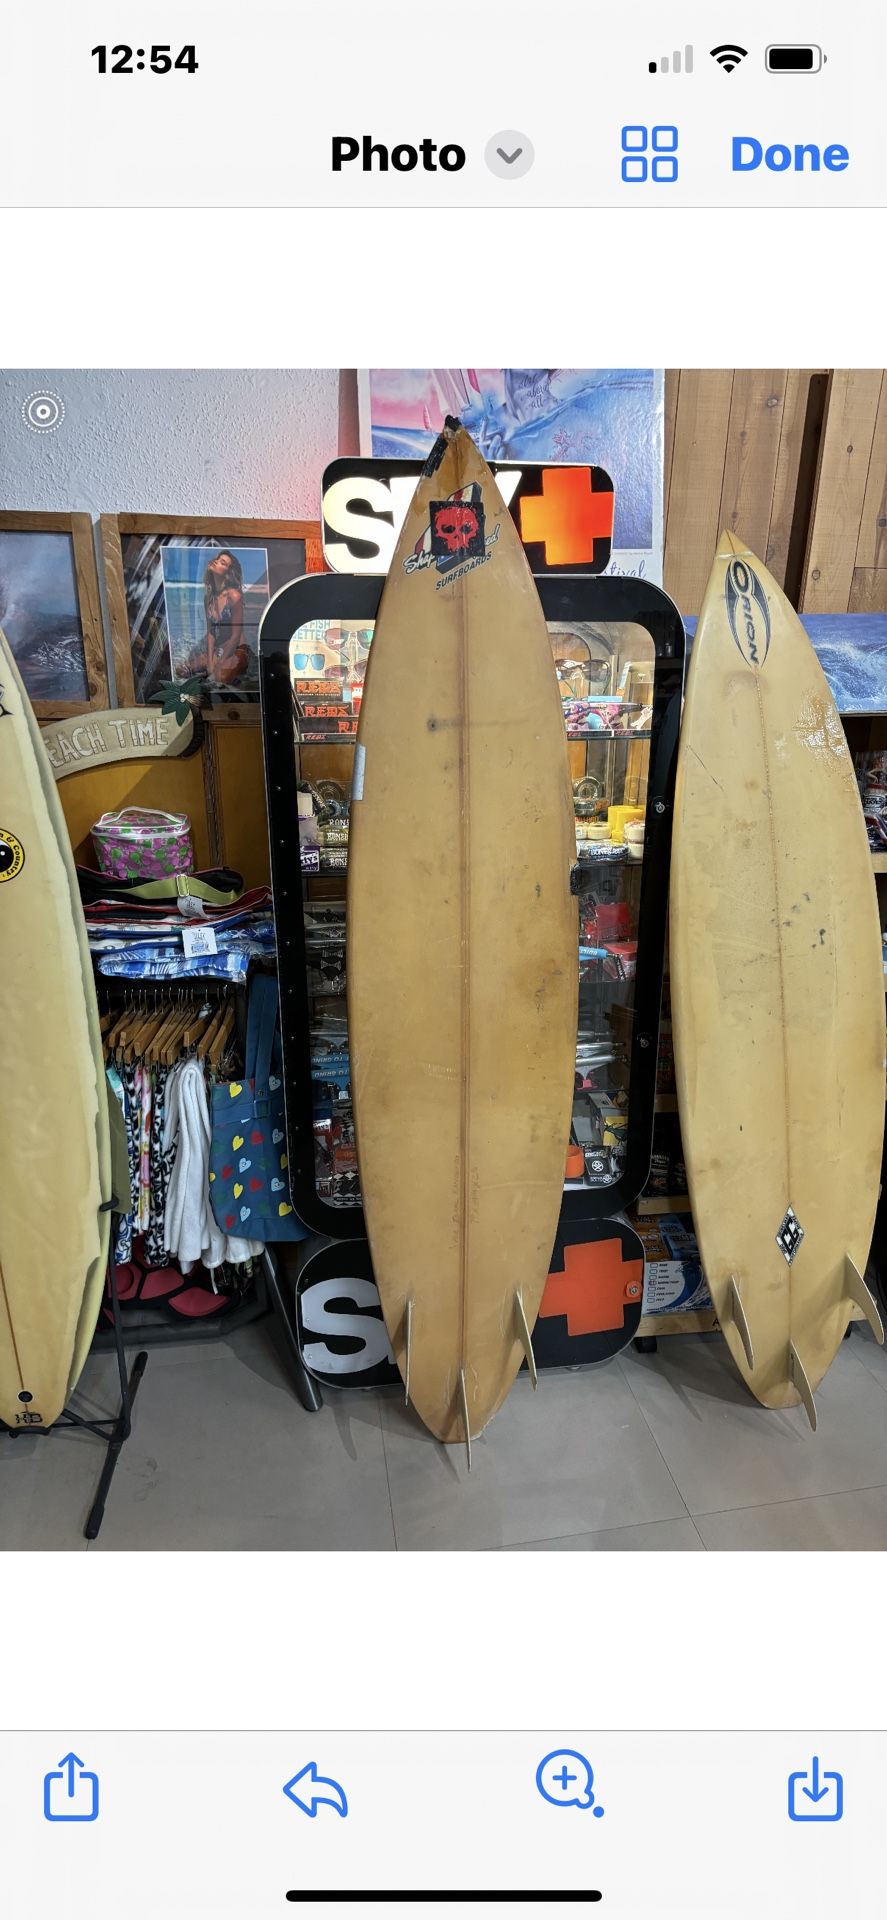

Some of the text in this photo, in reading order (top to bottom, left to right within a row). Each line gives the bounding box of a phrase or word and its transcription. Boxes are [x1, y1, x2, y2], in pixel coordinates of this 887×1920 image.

[435, 551, 492, 590] SURFBOARDS
[731, 560, 760, 665] ORION
[304, 704, 349, 717] REDS
[44, 716, 169, 769] EACH TIME
